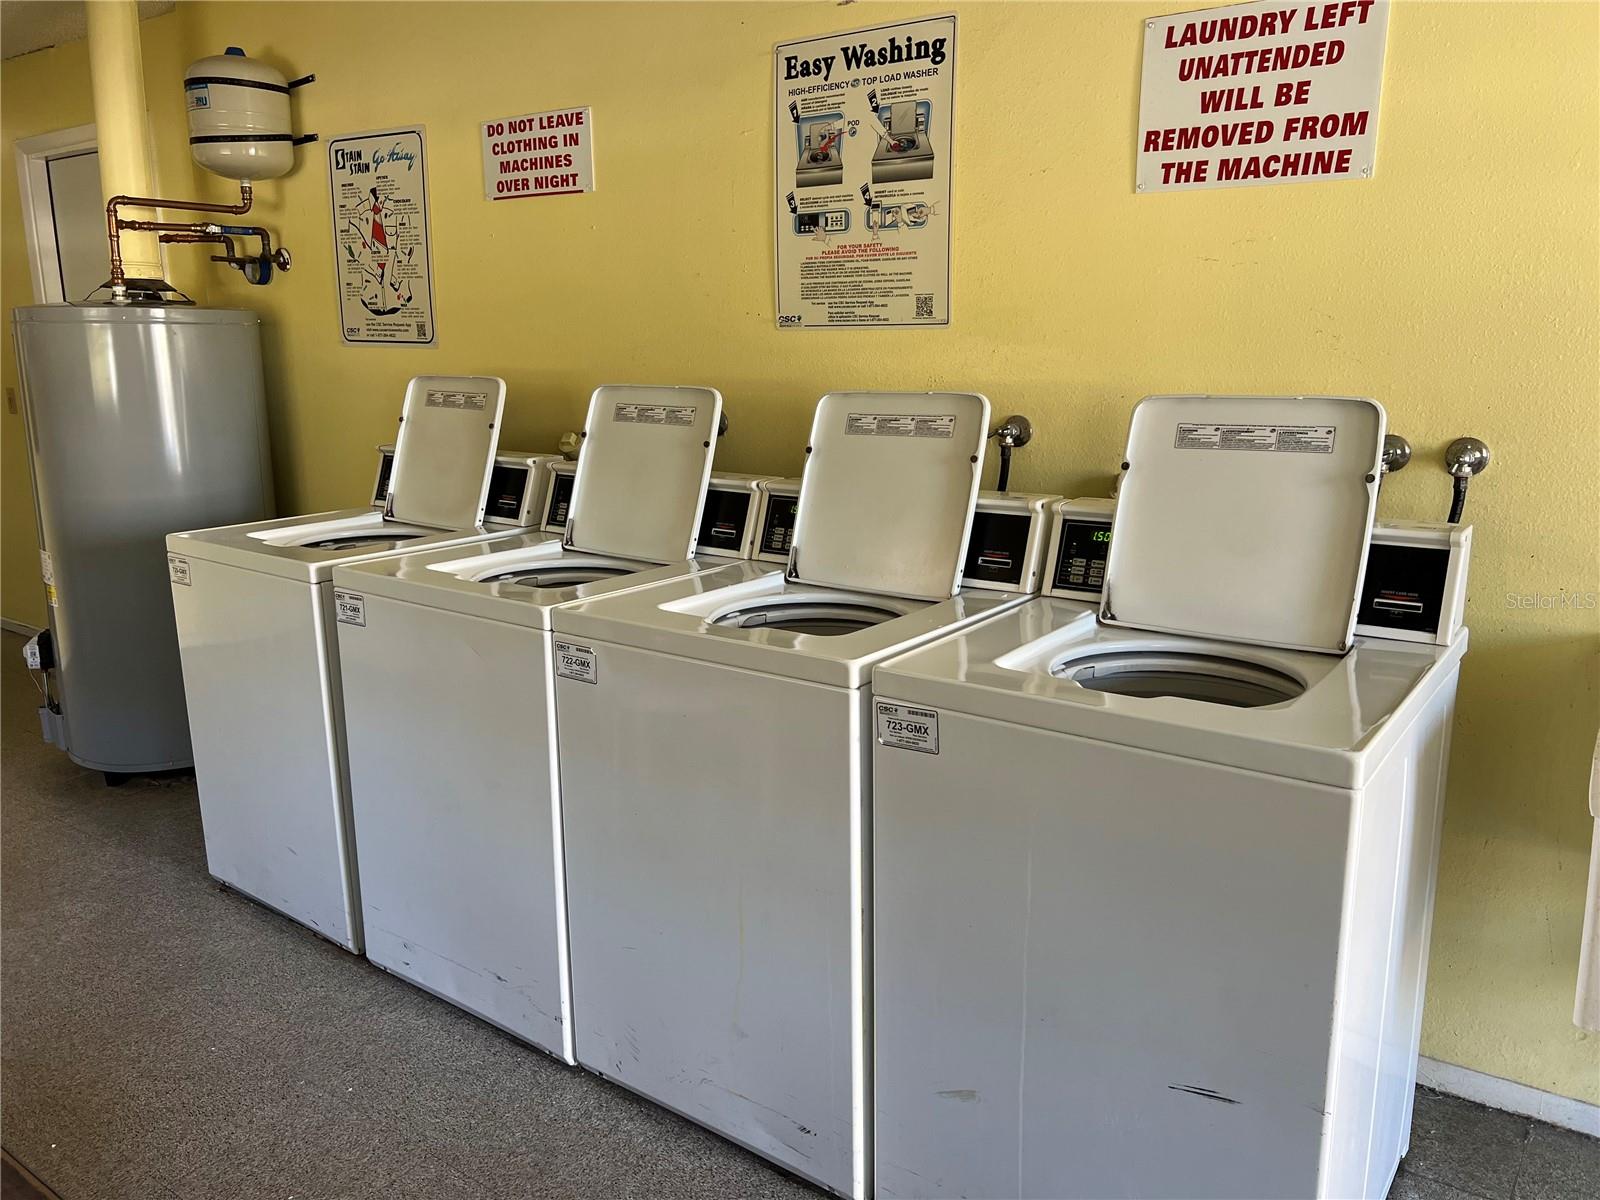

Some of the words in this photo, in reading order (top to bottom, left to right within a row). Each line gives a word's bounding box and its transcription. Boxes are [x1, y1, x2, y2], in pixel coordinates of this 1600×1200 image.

[1164, 9, 1298, 49] LAUNDRY
[1304, 0, 1375, 31] LEFT
[784, 55, 836, 82] Easy
[841, 36, 947, 71] Washing
[1178, 40, 1345, 82] UNATTENDED
[788, 80, 850, 97] HIGH-EFFICIENCY
[861, 77, 878, 86] TOP
[879, 73, 901, 84] LOAD
[903, 67, 939, 80] WASHER
[1200, 86, 1264, 114] WILL
[1273, 80, 1311, 107] BE
[487, 123, 504, 138] DO
[508, 118, 534, 134] NOT
[539, 112, 584, 130] LEAVE
[847, 119, 860, 127] POD
[1143, 120, 1275, 152] REMOVED
[1283, 110, 1369, 142] FROM
[492, 135, 558, 156] CLOTHING
[563, 133, 579, 147] IN
[350, 162, 370, 176] STAIN
[372, 147, 385, 173] Go
[387, 141, 417, 171] Away
[499, 154, 572, 174] MACHINES
[1161, 160, 1209, 185] THE
[1217, 149, 1352, 181] MACHINE
[496, 178, 530, 193] OVER
[534, 173, 578, 190] NIGHT
[778, 315, 796, 323] CSC
[1092, 531, 1112, 542] 150
[562, 656, 591, 669] 722-GMX
[886, 720, 930, 736] 723-GMX
